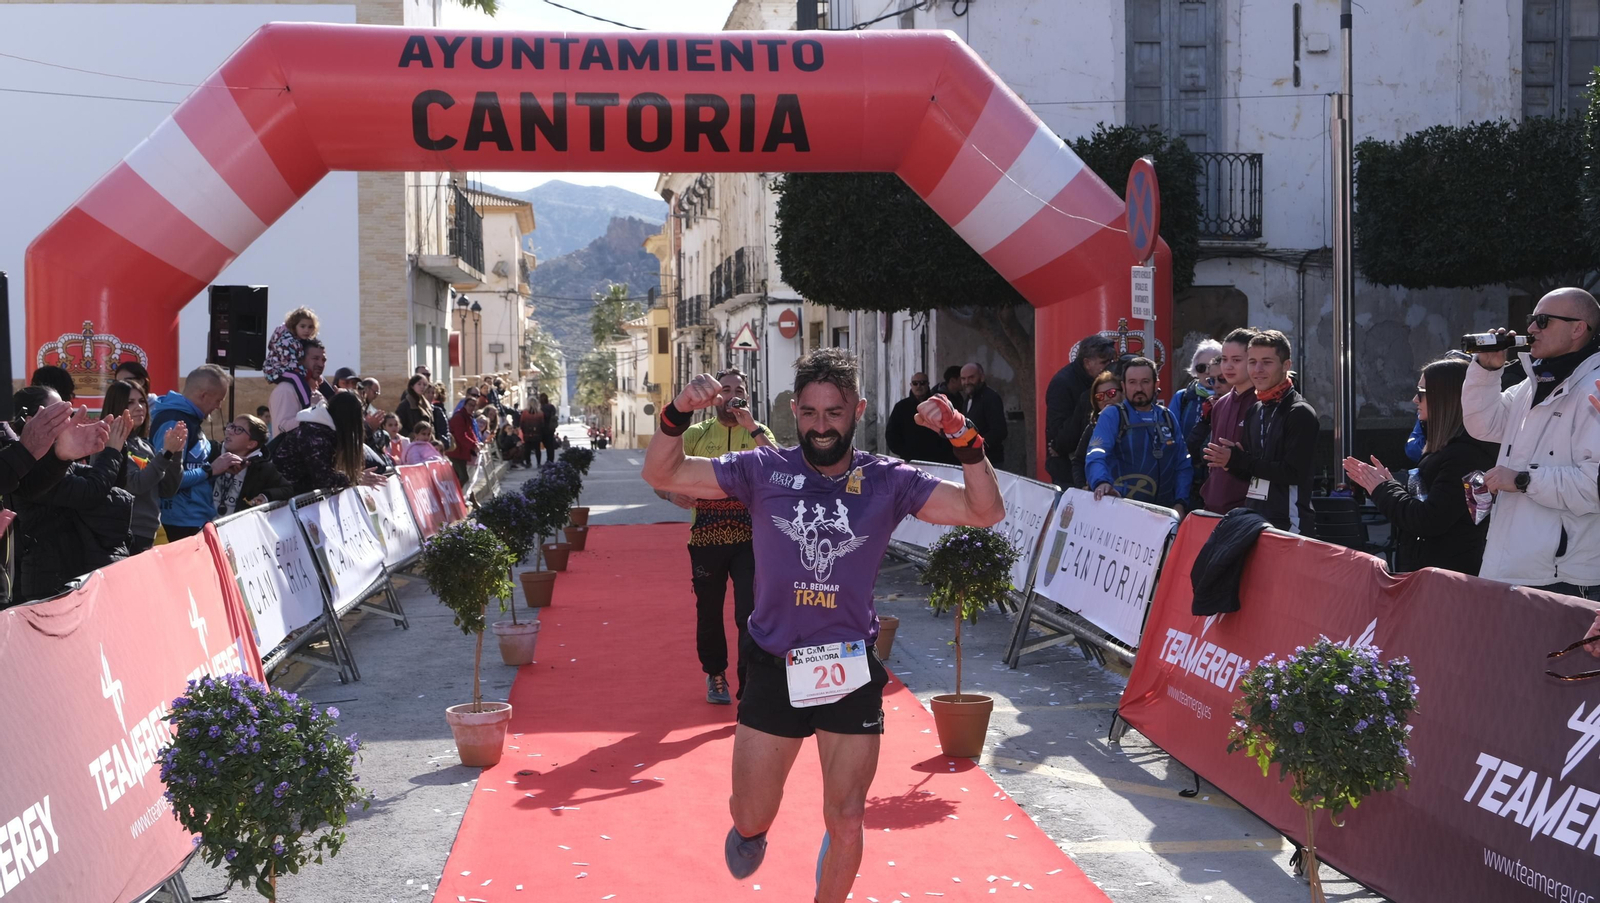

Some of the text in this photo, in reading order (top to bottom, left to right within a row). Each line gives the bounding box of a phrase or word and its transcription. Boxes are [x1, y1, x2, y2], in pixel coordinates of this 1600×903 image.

[398, 35, 824, 72] AYUNTAMIENTO
[411, 89, 811, 153] CANTORIA
[1074, 521, 1155, 566] AYUNTAMIENTO DE
[793, 581, 840, 592] C.D. BEDMAR
[1060, 541, 1148, 611] CANTORIA
[794, 590, 838, 609] TRAIL
[794, 653, 839, 666] LA PÓLVORA
[795, 648, 804, 657] IV
[806, 645, 826, 655] CxM
[1159, 628, 1247, 692] TEAMERGY
[813, 662, 846, 690] 20
[1167, 684, 1212, 720] www.teamergy.es
[0, 794, 59, 899] ERGY
